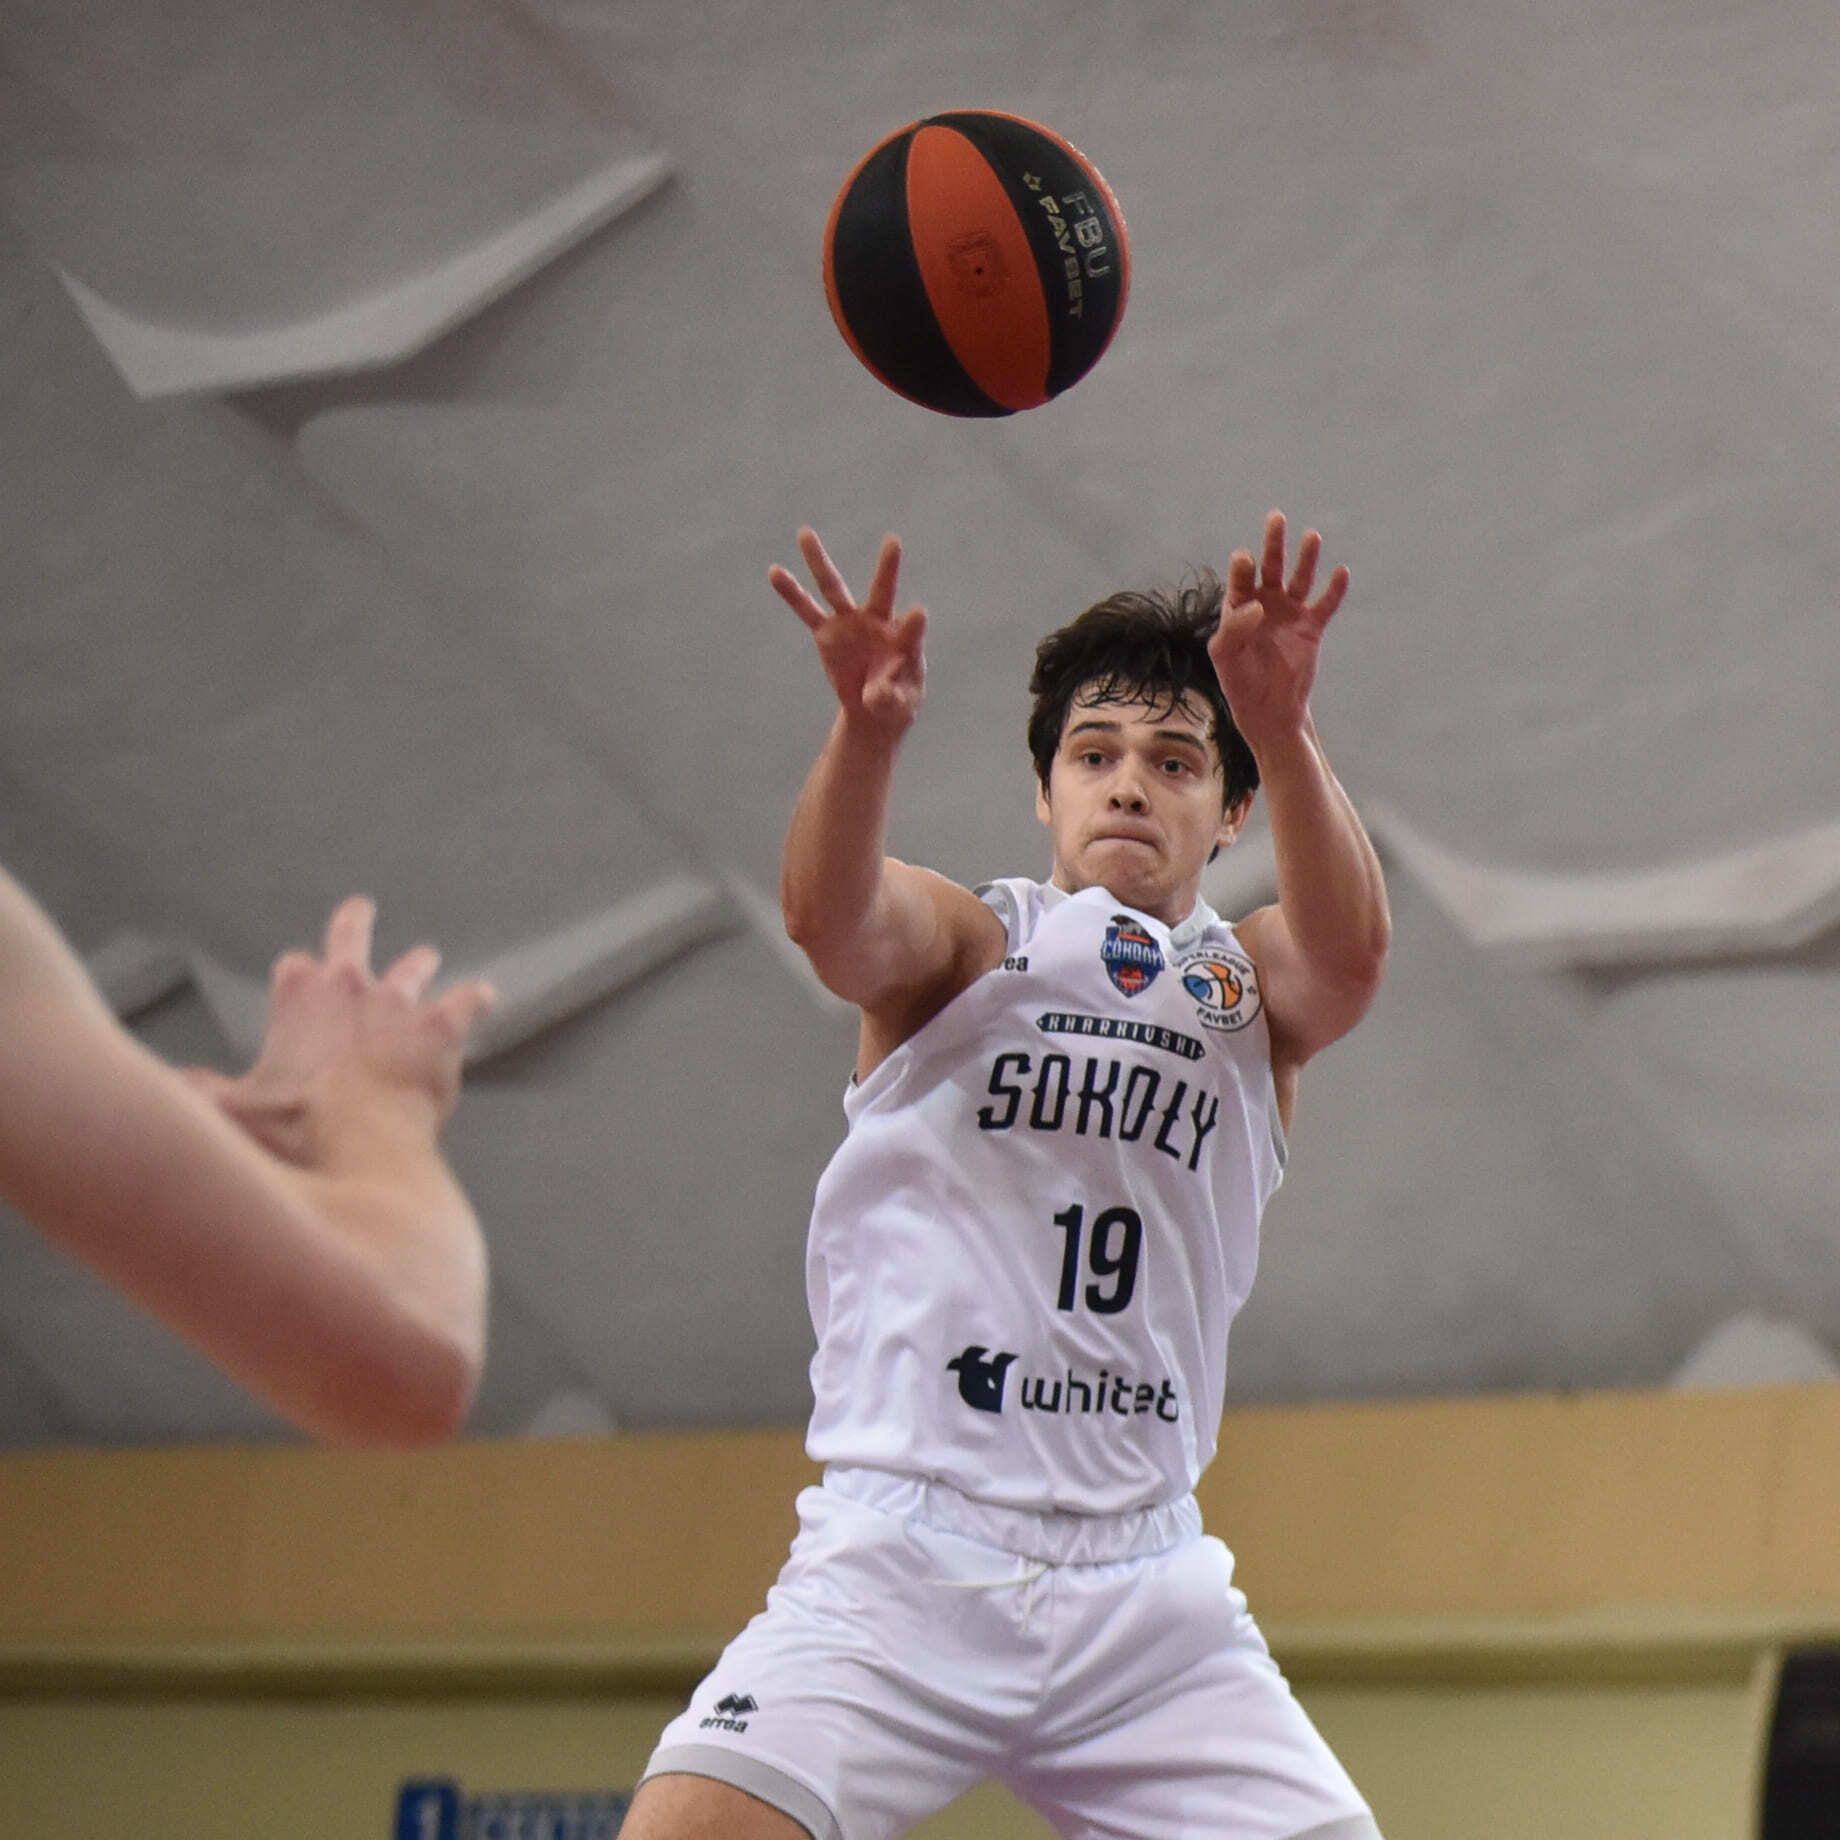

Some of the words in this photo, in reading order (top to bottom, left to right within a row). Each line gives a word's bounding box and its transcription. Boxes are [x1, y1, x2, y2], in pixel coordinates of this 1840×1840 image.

[1039, 195, 1084, 319] FAVBET
[1061, 191, 1111, 278] FBU
[1197, 1007, 1243, 1025] FAVBET
[1053, 1203, 1144, 1315] 19
